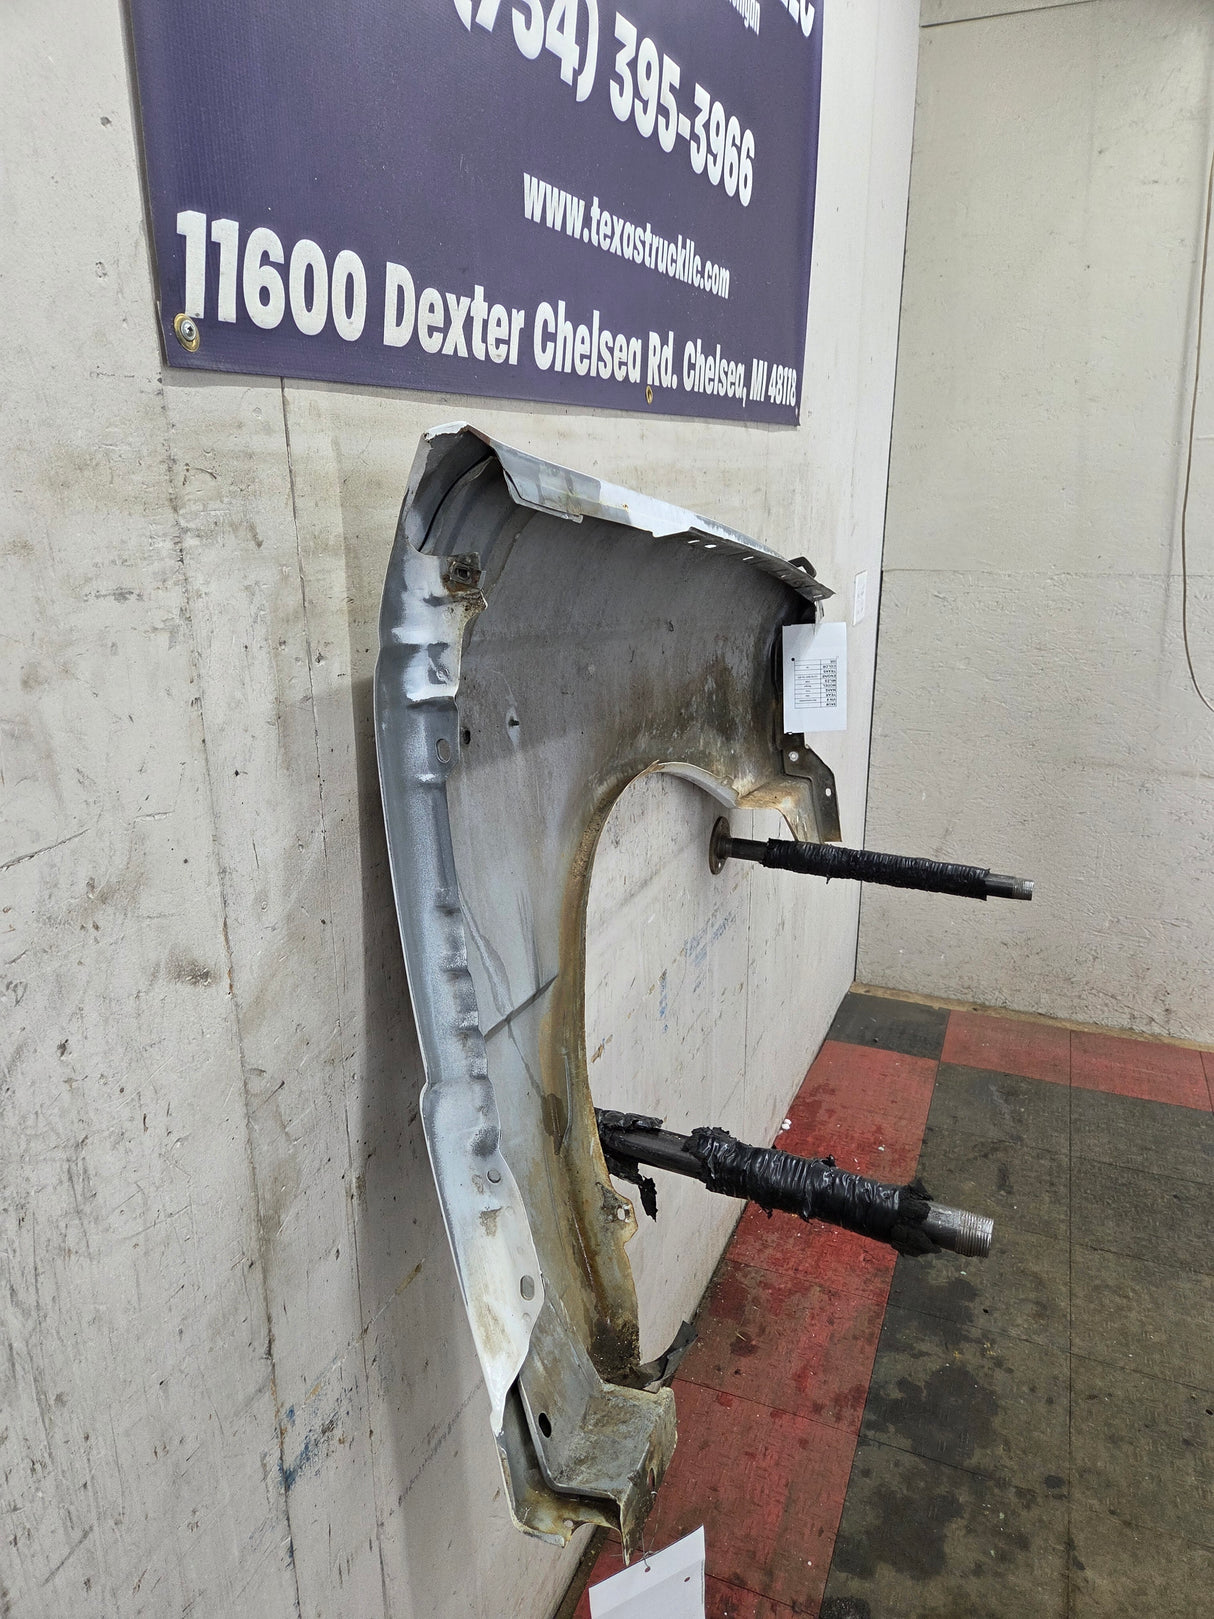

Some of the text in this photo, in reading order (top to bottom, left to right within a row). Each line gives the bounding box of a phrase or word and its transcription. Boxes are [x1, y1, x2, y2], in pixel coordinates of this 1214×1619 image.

[609, 11, 755, 207] 395-3966
[176, 210, 798, 408] 11600 Dexter Chelsea Rd. Chelsea, MI 48118
[523, 172, 731, 299] www.texastruckllc.com
